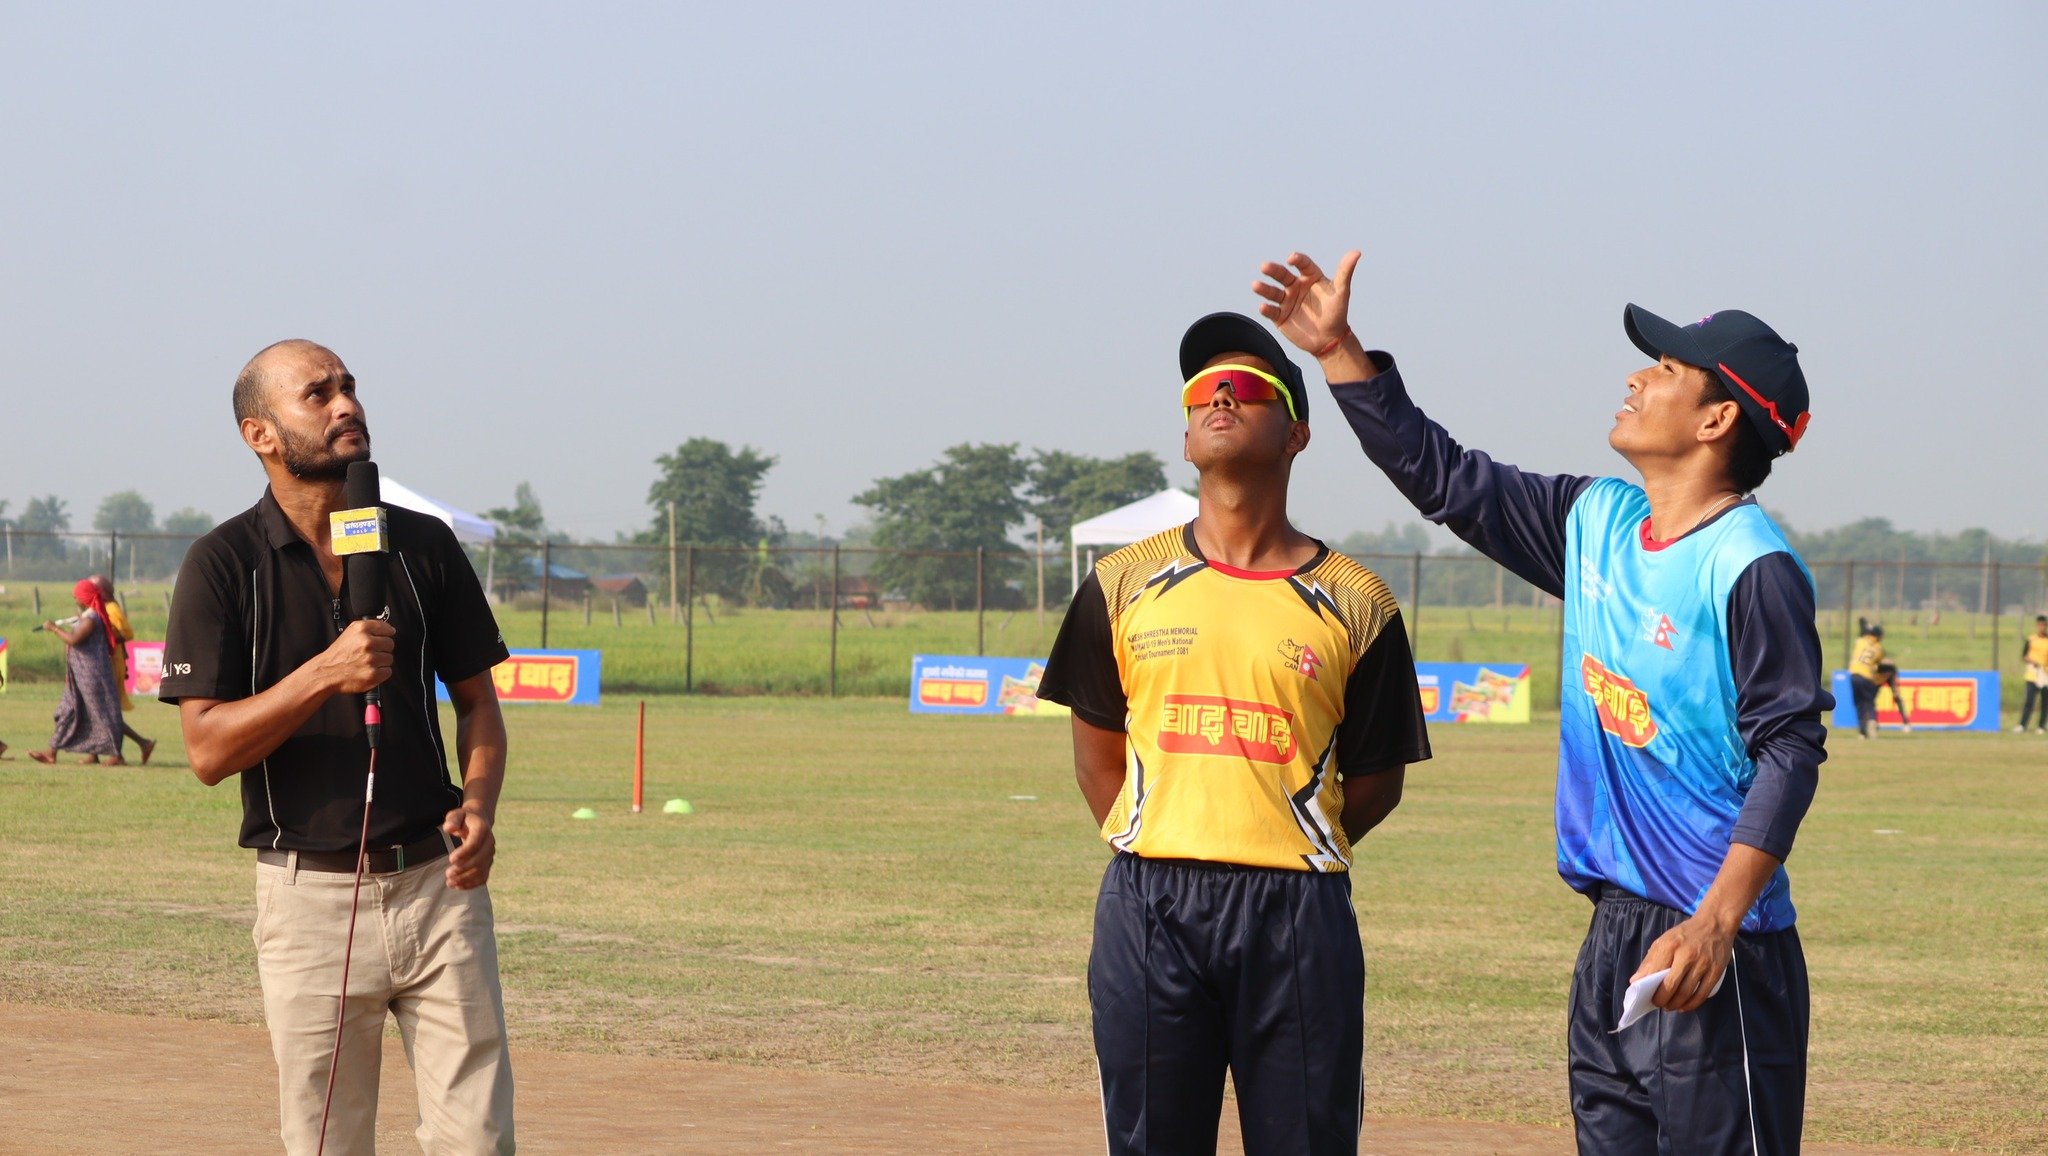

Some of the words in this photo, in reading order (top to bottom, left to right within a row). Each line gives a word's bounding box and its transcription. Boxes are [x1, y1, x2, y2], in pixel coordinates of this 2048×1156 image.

[1144, 629, 1169, 639] SHRESTHA
[1170, 627, 1198, 635] MEMORIAL
[1157, 638, 1171, 647] Men's
[1172, 637, 1193, 645] National
[1148, 648, 1175, 659] Tournament
[1177, 647, 1189, 655] 2081
[173, 663, 191, 675] Y-3
